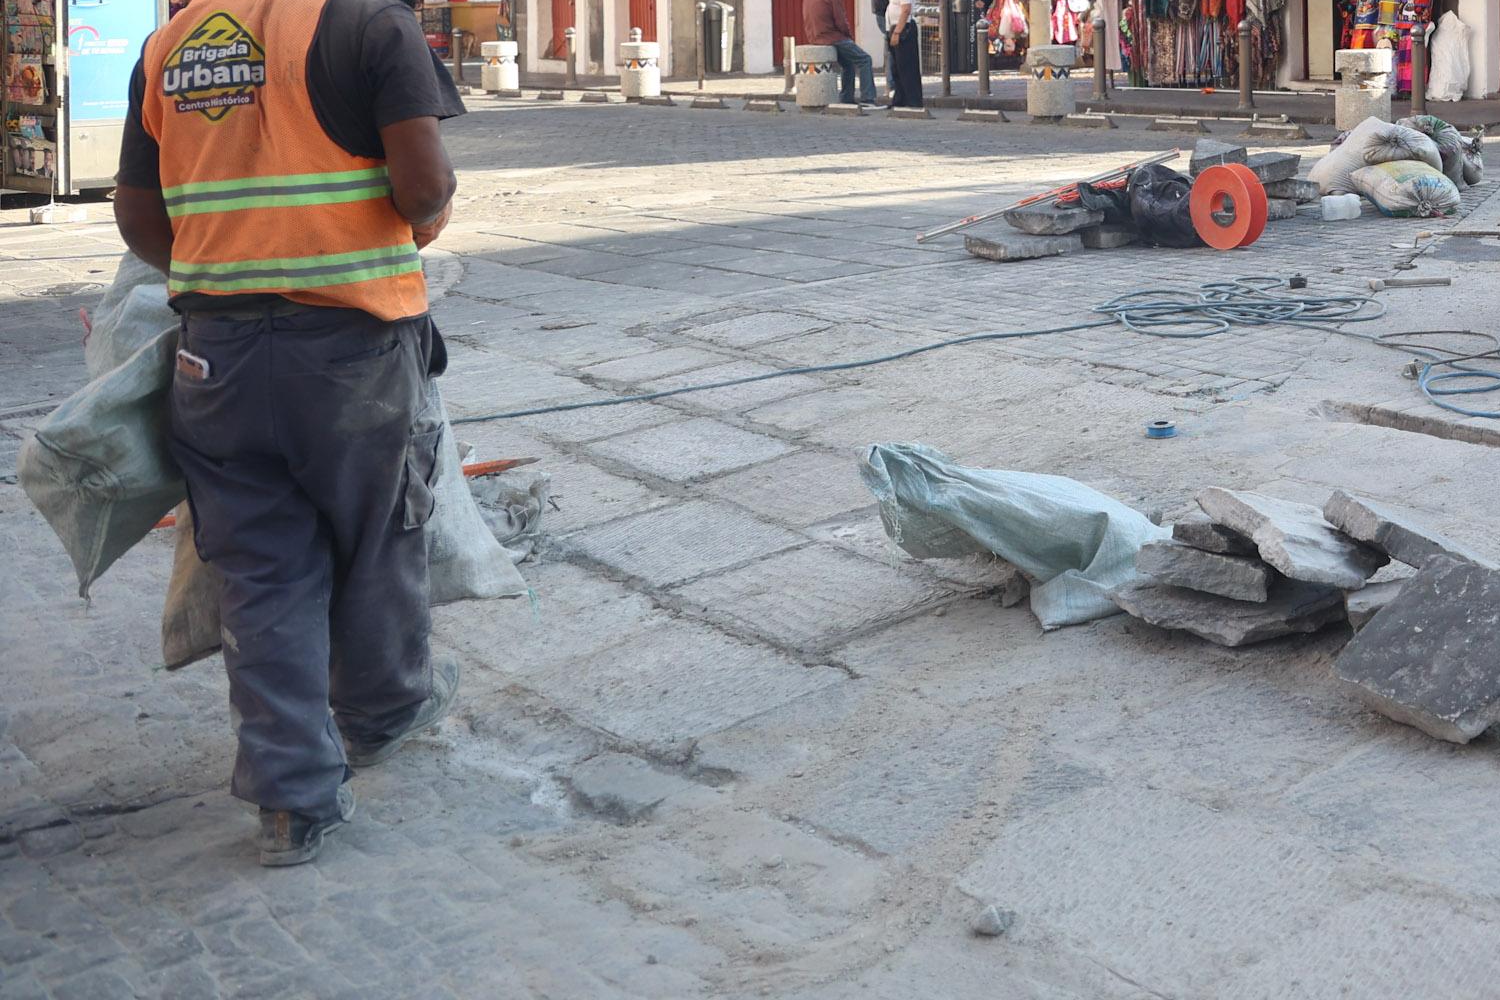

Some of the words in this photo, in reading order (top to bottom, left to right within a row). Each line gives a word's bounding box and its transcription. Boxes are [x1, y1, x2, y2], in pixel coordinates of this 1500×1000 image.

[182, 41, 249, 63] Brigada
[163, 62, 265, 92] Urbana
[178, 100, 211, 111] Centro
[210, 95, 250, 107] Histórico
